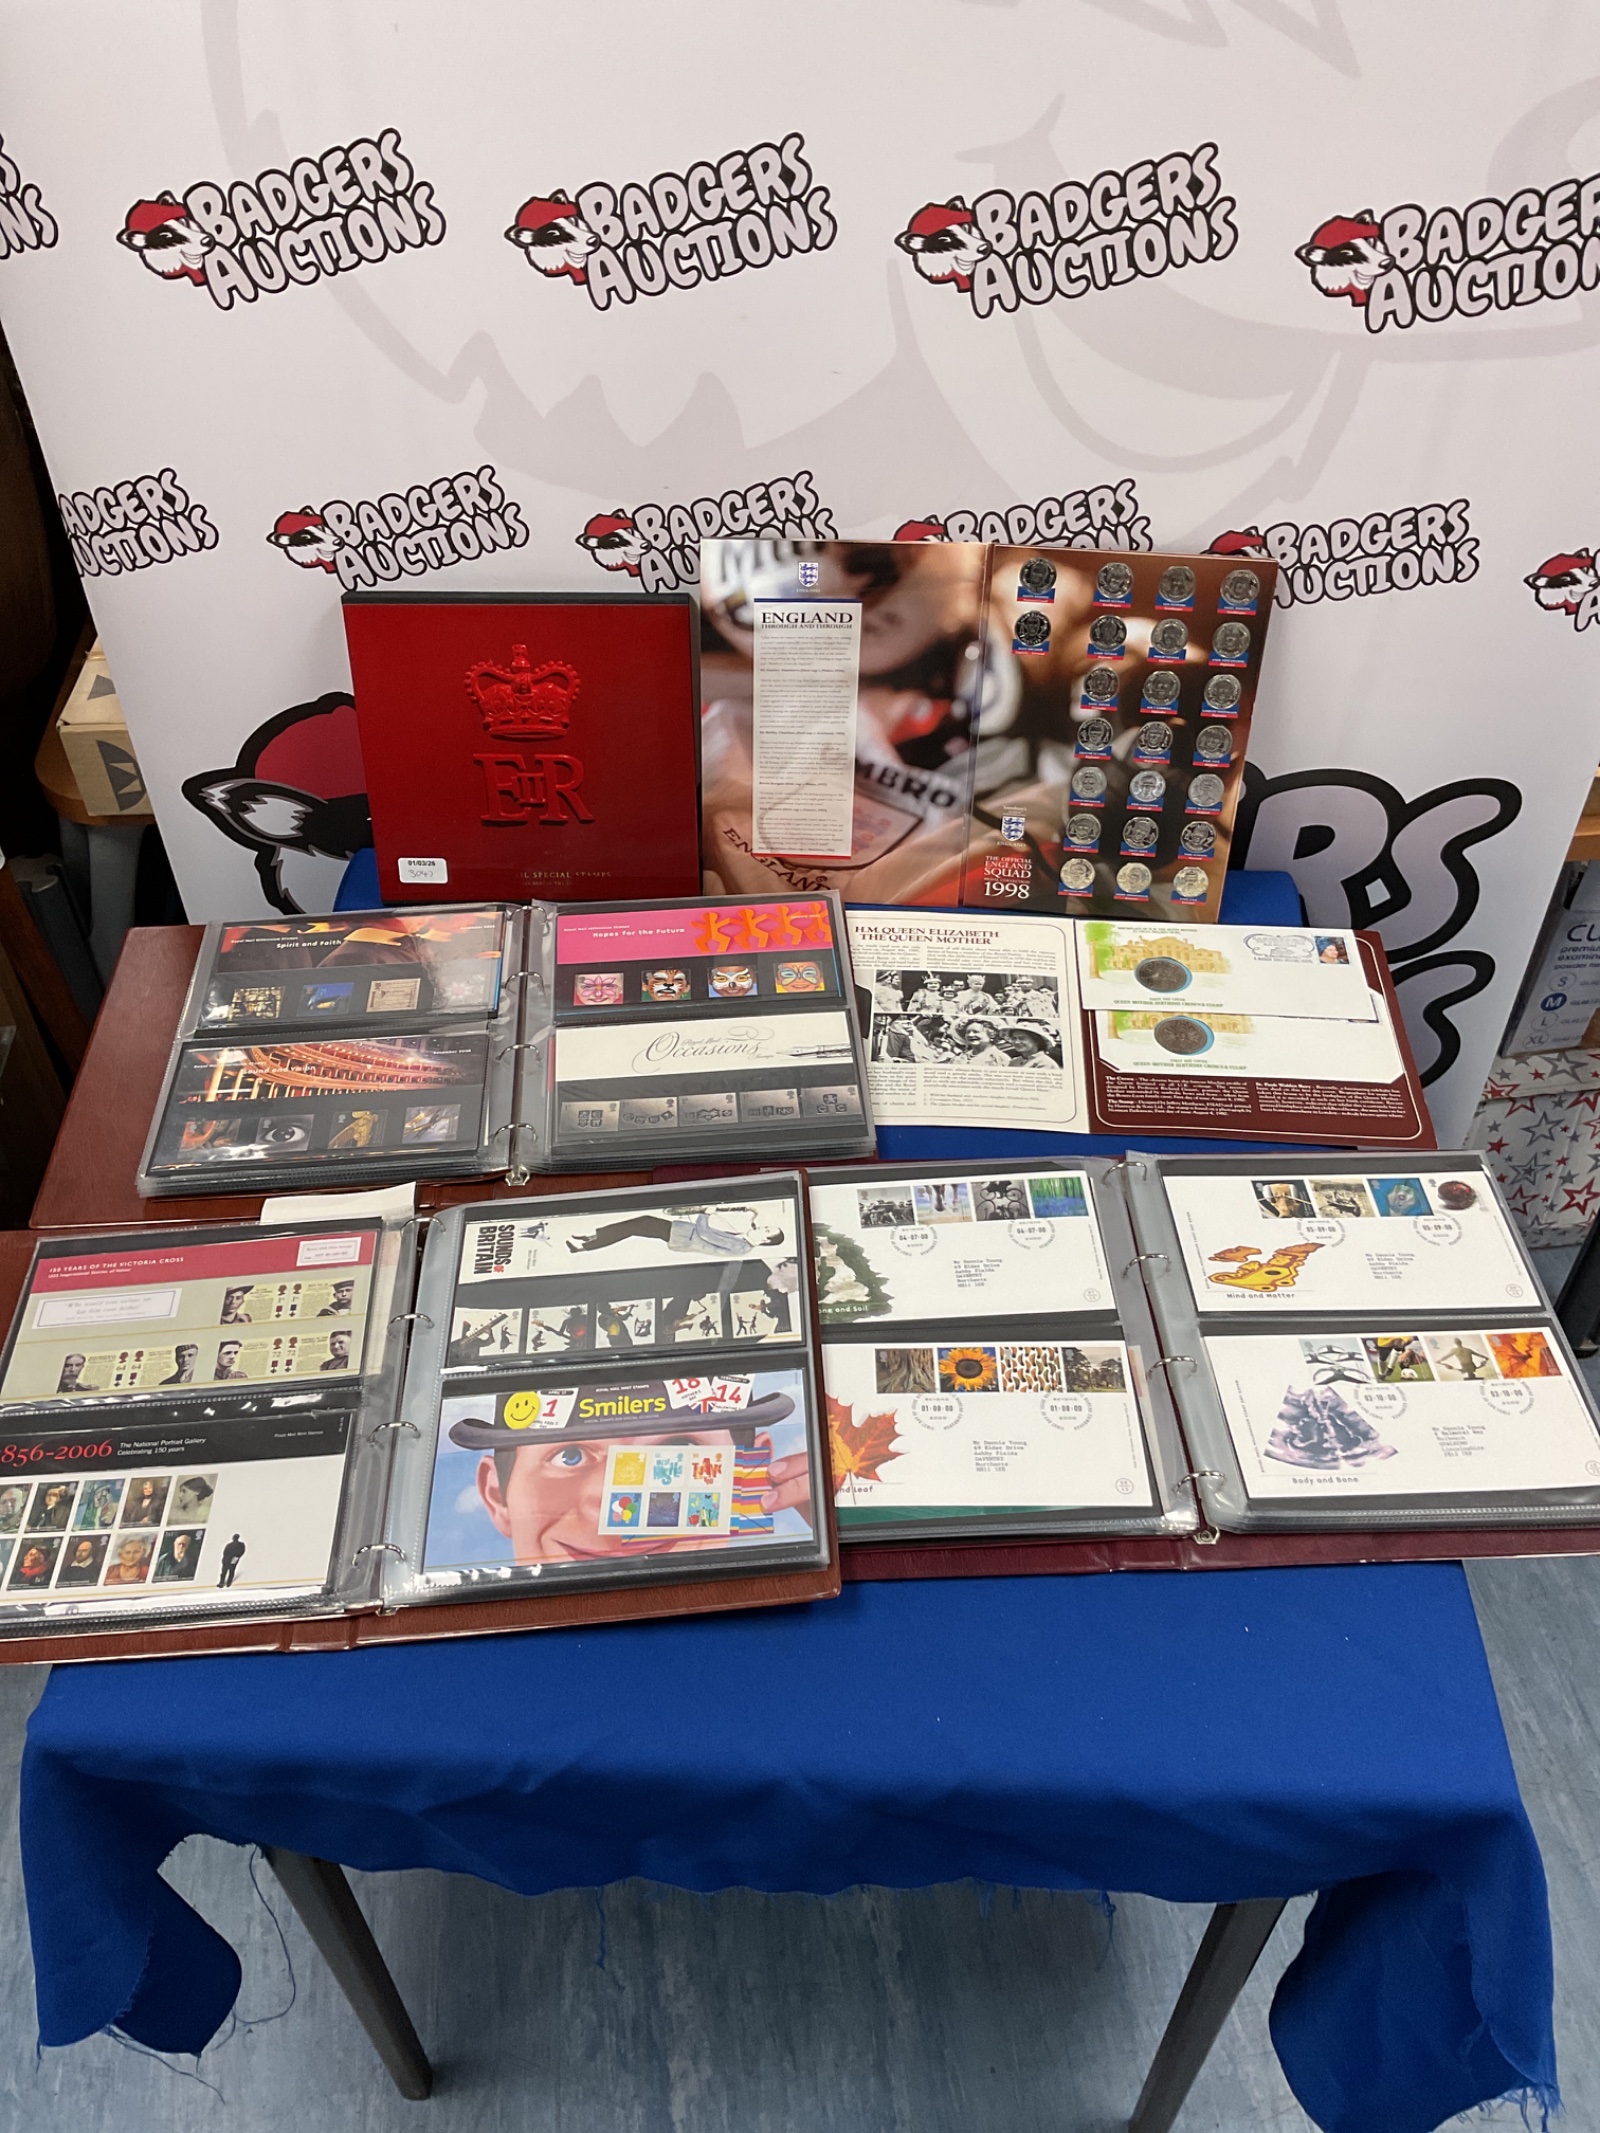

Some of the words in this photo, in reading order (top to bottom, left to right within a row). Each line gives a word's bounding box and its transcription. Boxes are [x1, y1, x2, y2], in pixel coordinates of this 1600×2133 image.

[182, 127, 413, 249] BADGERS
[575, 132, 812, 250] BADGERS
[972, 142, 1222, 256] BADGERS
[203, 181, 446, 310] AUCTIONS
[586, 186, 837, 311] AUCTIONS
[970, 197, 1238, 318] AUCTIONS
[58, 467, 189, 535] ADGERS
[320, 464, 504, 548] BADGERS
[632, 470, 818, 551] BADGERS
[945, 478, 1137, 544] BADGERS
[68, 504, 219, 577] UCTIONS
[1264, 498, 1470, 570] BADGERS
[335, 502, 529, 590] AUCTIONS
[761, 612, 853, 624] ENGLAND
[985, 860, 1032, 870] ENGLAND
[1001, 856, 1032, 864] OFFICIAL
[984, 868, 1031, 878] SQUAD
[984, 881, 1030, 899] 1998
[592, 931, 619, 939] Hopes
[860, 933, 887, 941] THE
[888, 934, 933, 943] QUEEN
[935, 936, 992, 945] MOTHER
[881, 927, 926, 936] QUEEN
[928, 929, 999, 938] ELIZABETH
[1557, 975, 1569, 988] S
[1545, 996, 1563, 1008] M
[1540, 1016, 1548, 1026] L
[634, 1031, 762, 1066] Occasions
[1528, 1034, 1546, 1045] XL
[473, 1225, 498, 1275] BRITAIN
[493, 1224, 516, 1266] SOUNDS
[119, 1259, 157, 1267] VICTORIA
[159, 1256, 185, 1264] CROSS
[671, 1377, 701, 1395] 18
[716, 1383, 742, 1404] 14
[542, 1398, 558, 1418] 1
[578, 1394, 667, 1419] Smilers
[0, 1438, 113, 1468] 856-2006
[116, 1448, 153, 1457] Celebrating
[133, 1440, 160, 1448] National
[853, 1484, 874, 1493] Leaf
[1291, 1476, 1314, 1485] Body
